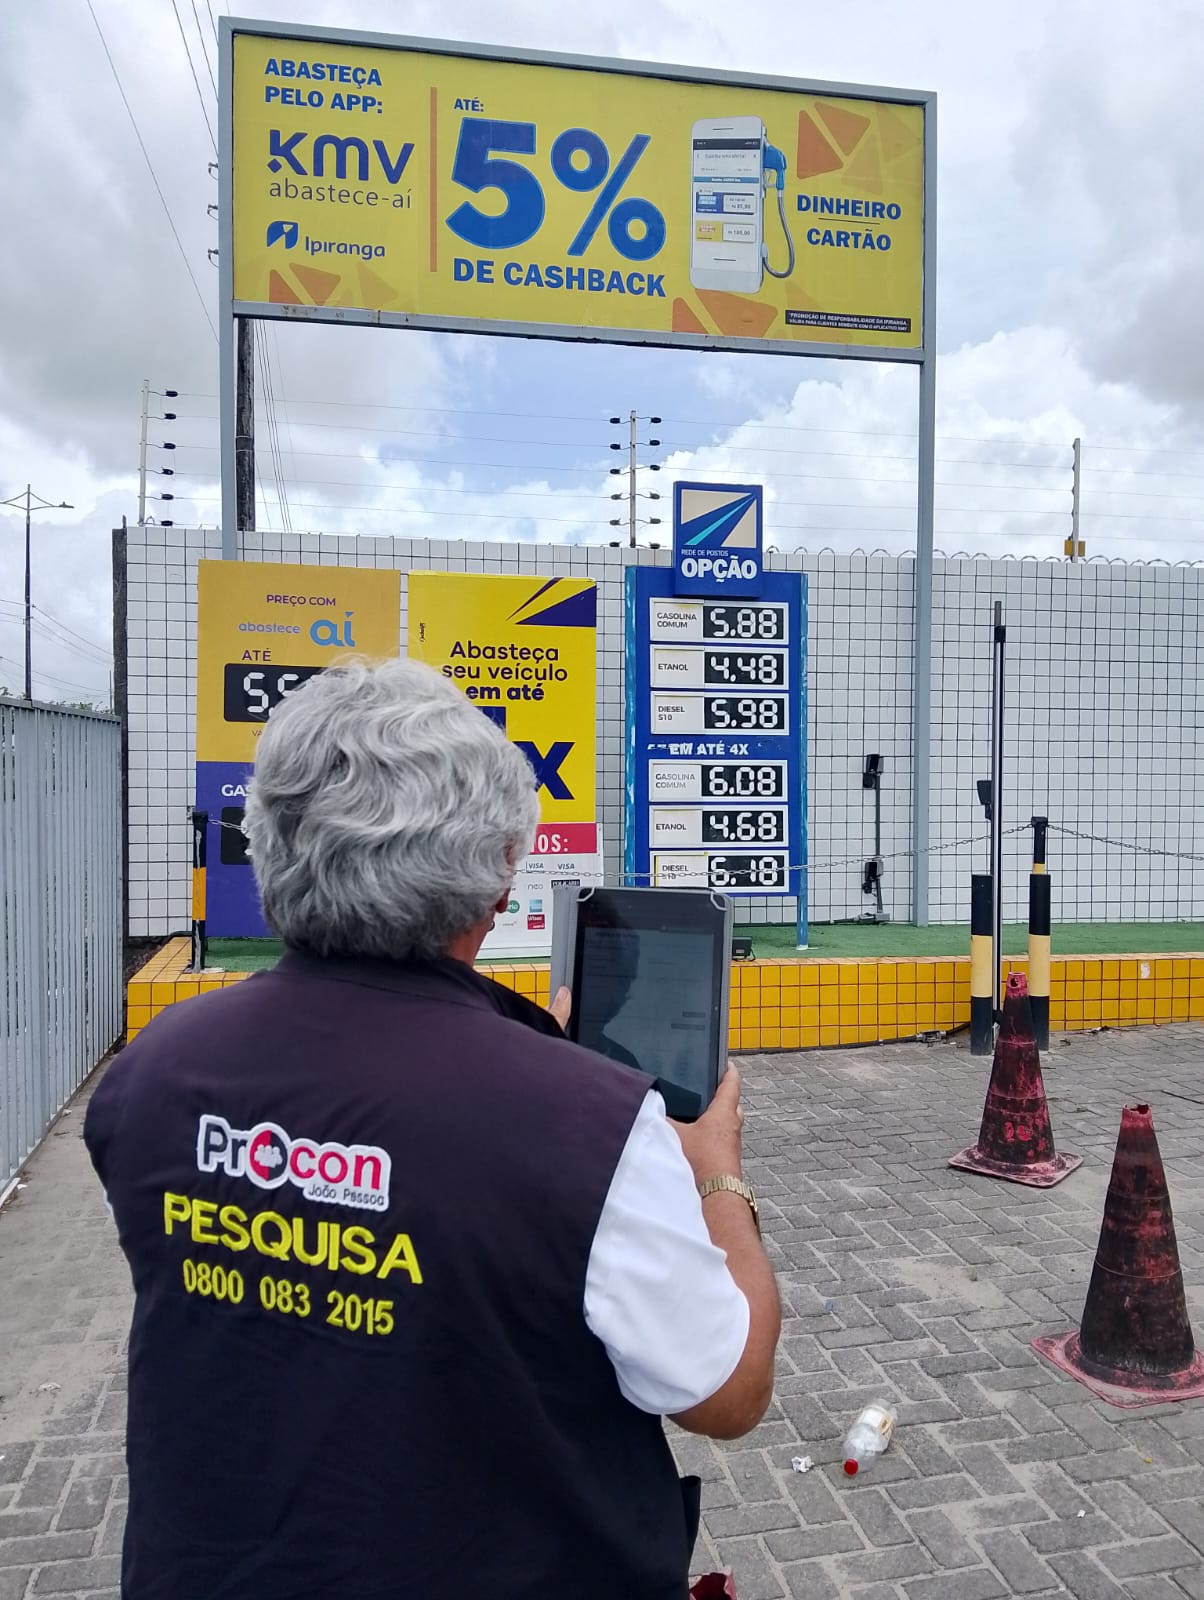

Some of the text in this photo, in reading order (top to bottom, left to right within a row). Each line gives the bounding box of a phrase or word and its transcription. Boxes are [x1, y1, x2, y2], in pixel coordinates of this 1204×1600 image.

[265, 58, 382, 89] ABASTEÇA
[265, 86, 383, 114] PELO APP:
[454, 97, 484, 112] ATÉ:
[269, 178, 412, 209] abastece-aí
[445, 116, 667, 262] 5%
[797, 194, 902, 220] DINHEIRO
[305, 236, 386, 260] Ipiranga
[807, 228, 892, 251] CARTÃO
[454, 258, 666, 298] DE CASHBACK
[681, 555, 758, 583] OPÇÃO
[266, 594, 336, 607] PREÇO COM
[657, 612, 697, 621] GASOLINA
[657, 621, 688, 629] COMUM
[710, 608, 778, 638] 5.88
[238, 611, 356, 648] abastece aí
[242, 648, 272, 662] ATÉ
[450, 640, 559, 664] Abasteça
[442, 663, 568, 682] seu veículo
[658, 663, 689, 671] ETANOL
[710, 655, 778, 683] 4.48
[465, 683, 545, 701] em até
[658, 705, 685, 713] DIESEL
[711, 699, 778, 728] 5.98
[669, 740, 749, 755] EM ATÉ 4X
[655, 773, 696, 781] GASOLINA
[655, 781, 687, 789] COMUM
[709, 766, 776, 796] 6.08
[655, 823, 687, 831] ETANOL
[709, 812, 777, 841] 4.68
[662, 864, 689, 872] DIESEL
[710, 856, 778, 886] 6.18
[527, 883, 544, 891] neo
[308, 1183, 384, 1206] João Pessoa
[163, 1191, 424, 1285] PESQUISA
[182, 1258, 395, 1336] 0800 083 2015
